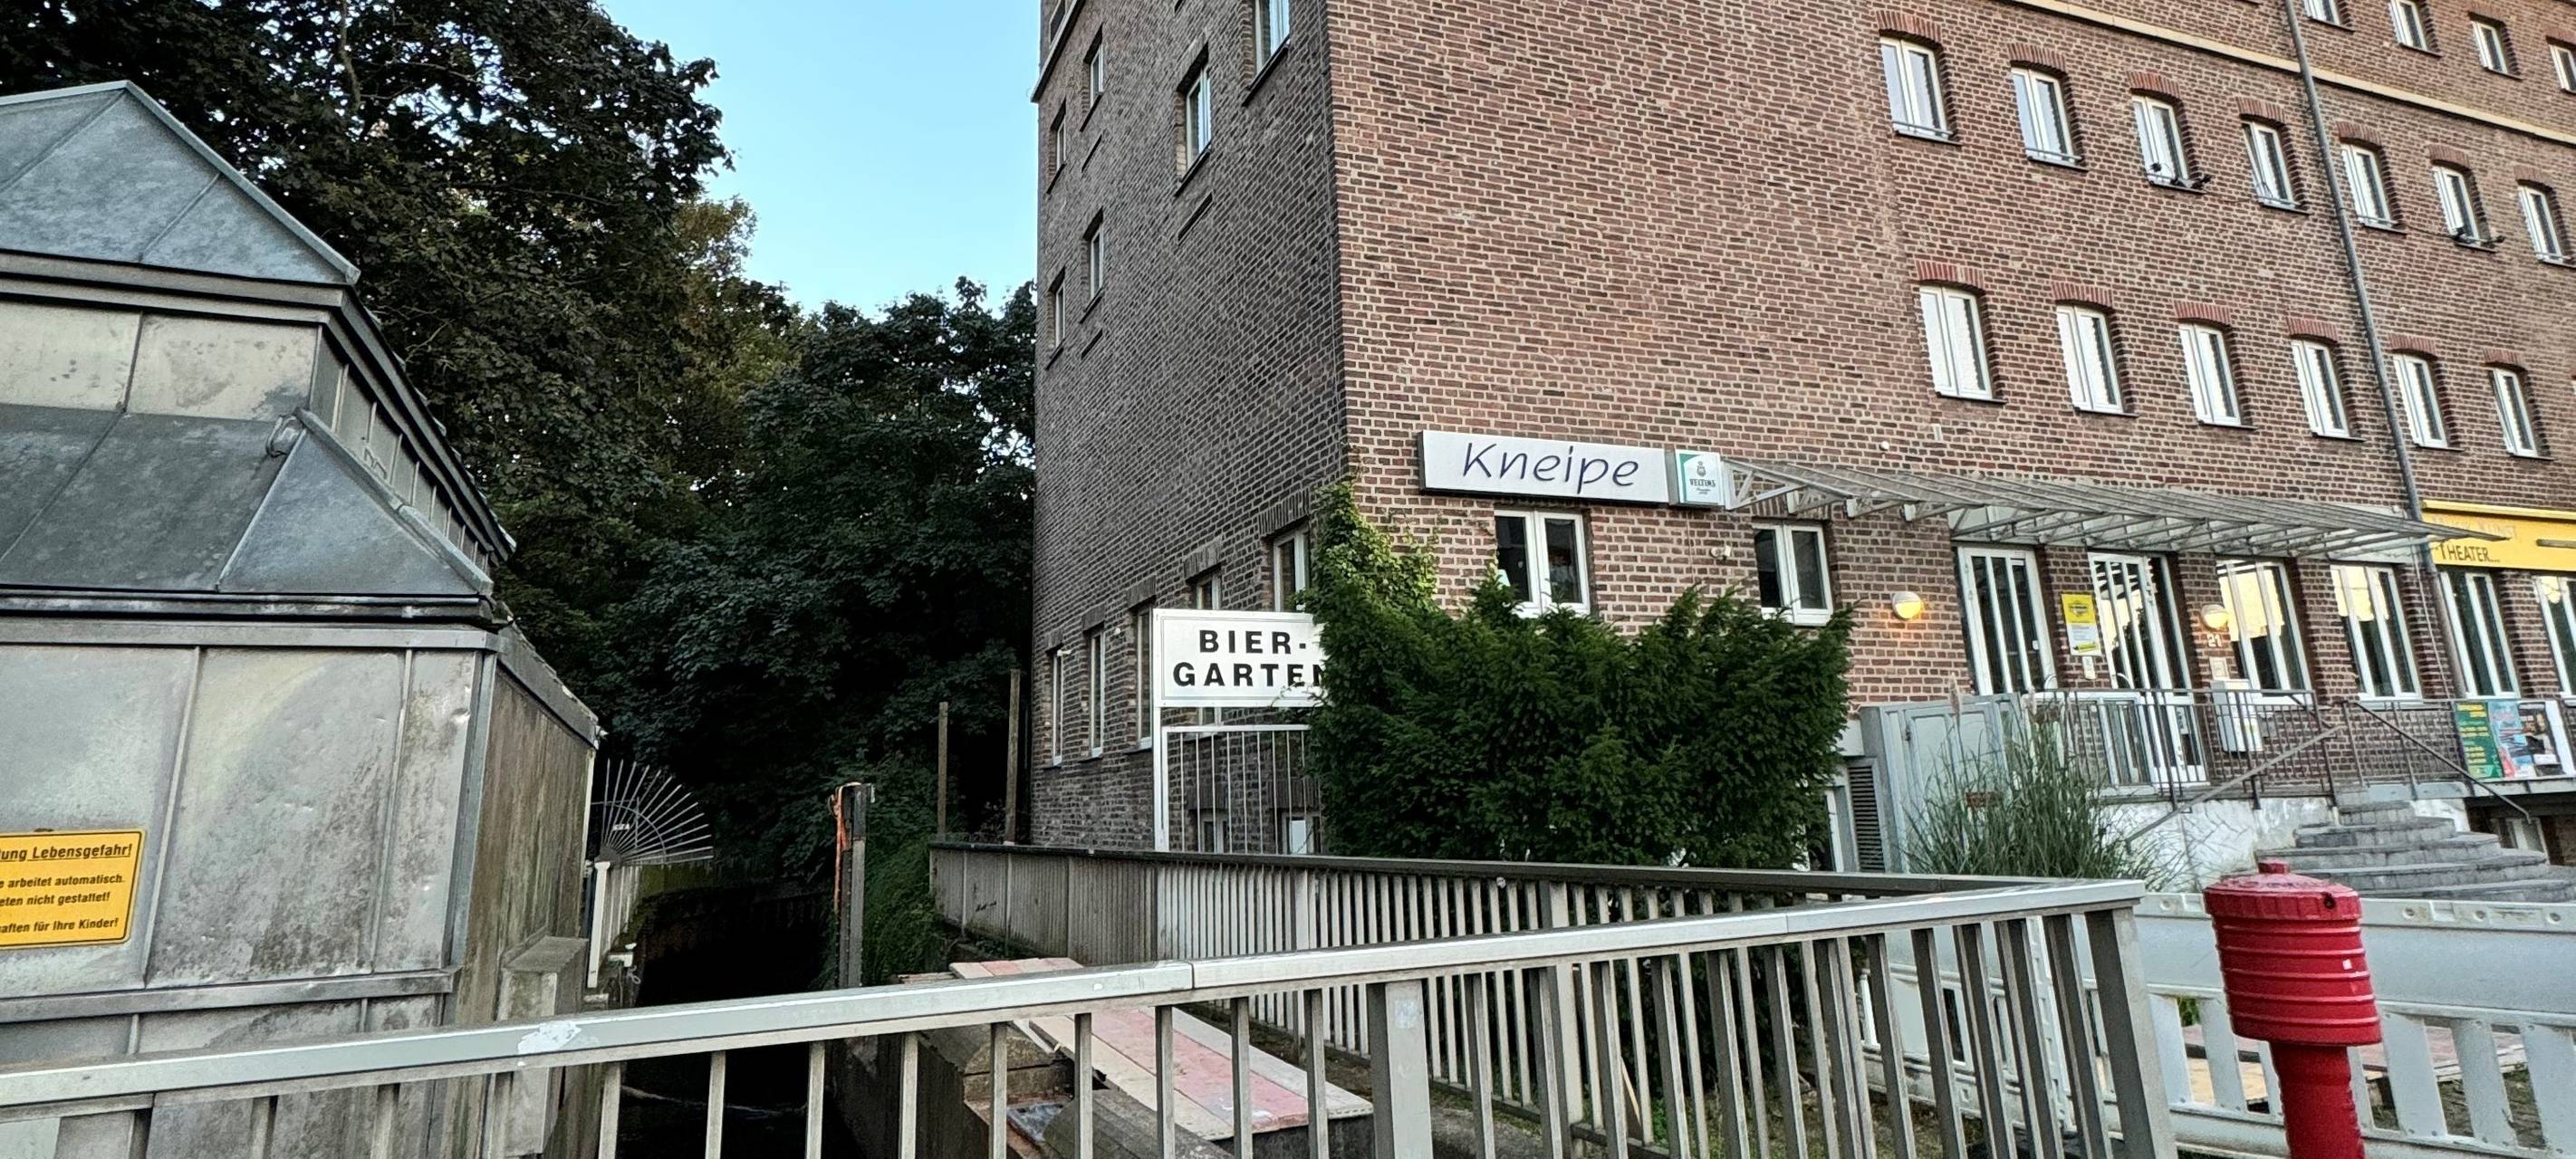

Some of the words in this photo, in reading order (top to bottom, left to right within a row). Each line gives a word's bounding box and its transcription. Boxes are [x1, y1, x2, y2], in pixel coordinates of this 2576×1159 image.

[1463, 442, 1639, 494] Kneipe
[1199, 629, 1306, 654] BIER-
[2206, 633, 2223, 647] 21
[0, 848, 28, 862] ung
[33, 843, 133, 859] Lebensgefahr!
[7, 876, 52, 888] arbeitet
[54, 873, 125, 886] automatisch.
[26, 894, 54, 905] nicht
[58, 891, 111, 906] gestattet!
[34, 920, 50, 932] für
[53, 920, 75, 931] Ihre
[79, 917, 119, 930] Kinder!
